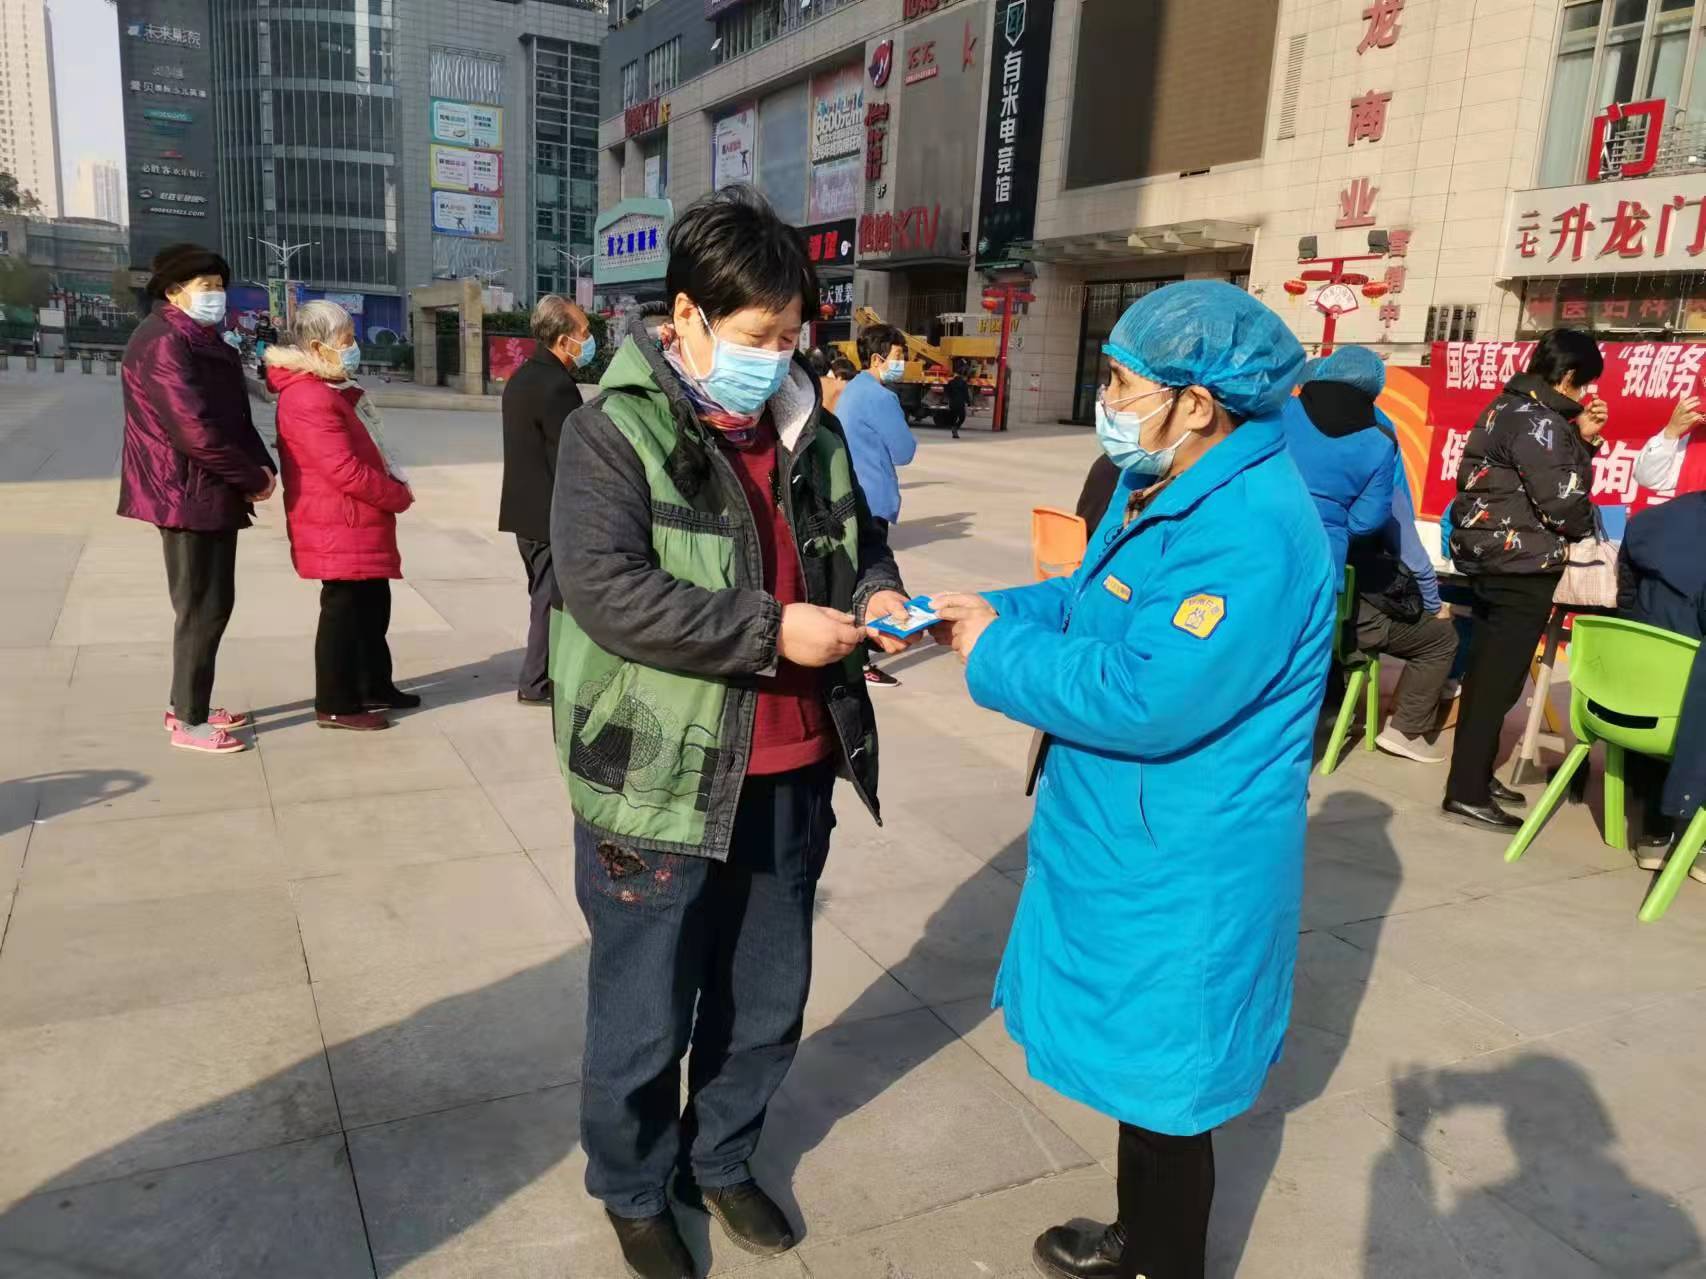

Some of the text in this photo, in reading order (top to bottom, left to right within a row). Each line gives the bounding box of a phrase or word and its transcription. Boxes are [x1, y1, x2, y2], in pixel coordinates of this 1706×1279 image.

[1546, 193, 1706, 264] 升龙门
[1589, 440, 1645, 504] 询
